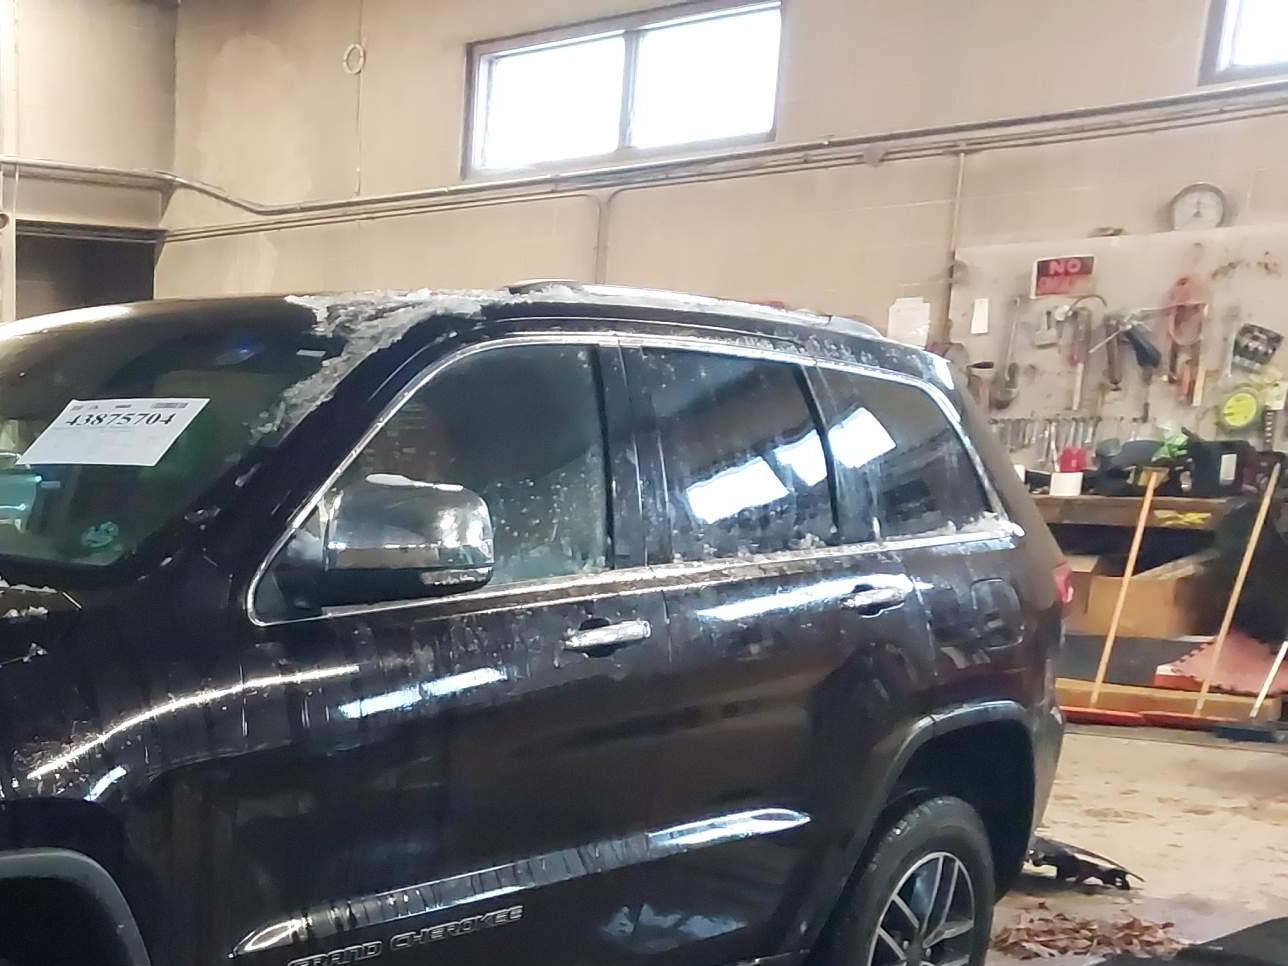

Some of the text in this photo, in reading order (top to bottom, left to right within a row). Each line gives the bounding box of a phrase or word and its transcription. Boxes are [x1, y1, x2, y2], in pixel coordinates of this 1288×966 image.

[1049, 259, 1081, 275] NO
[65, 412, 177, 426] 43875704
[390, 905, 525, 951] CHEROKEE
